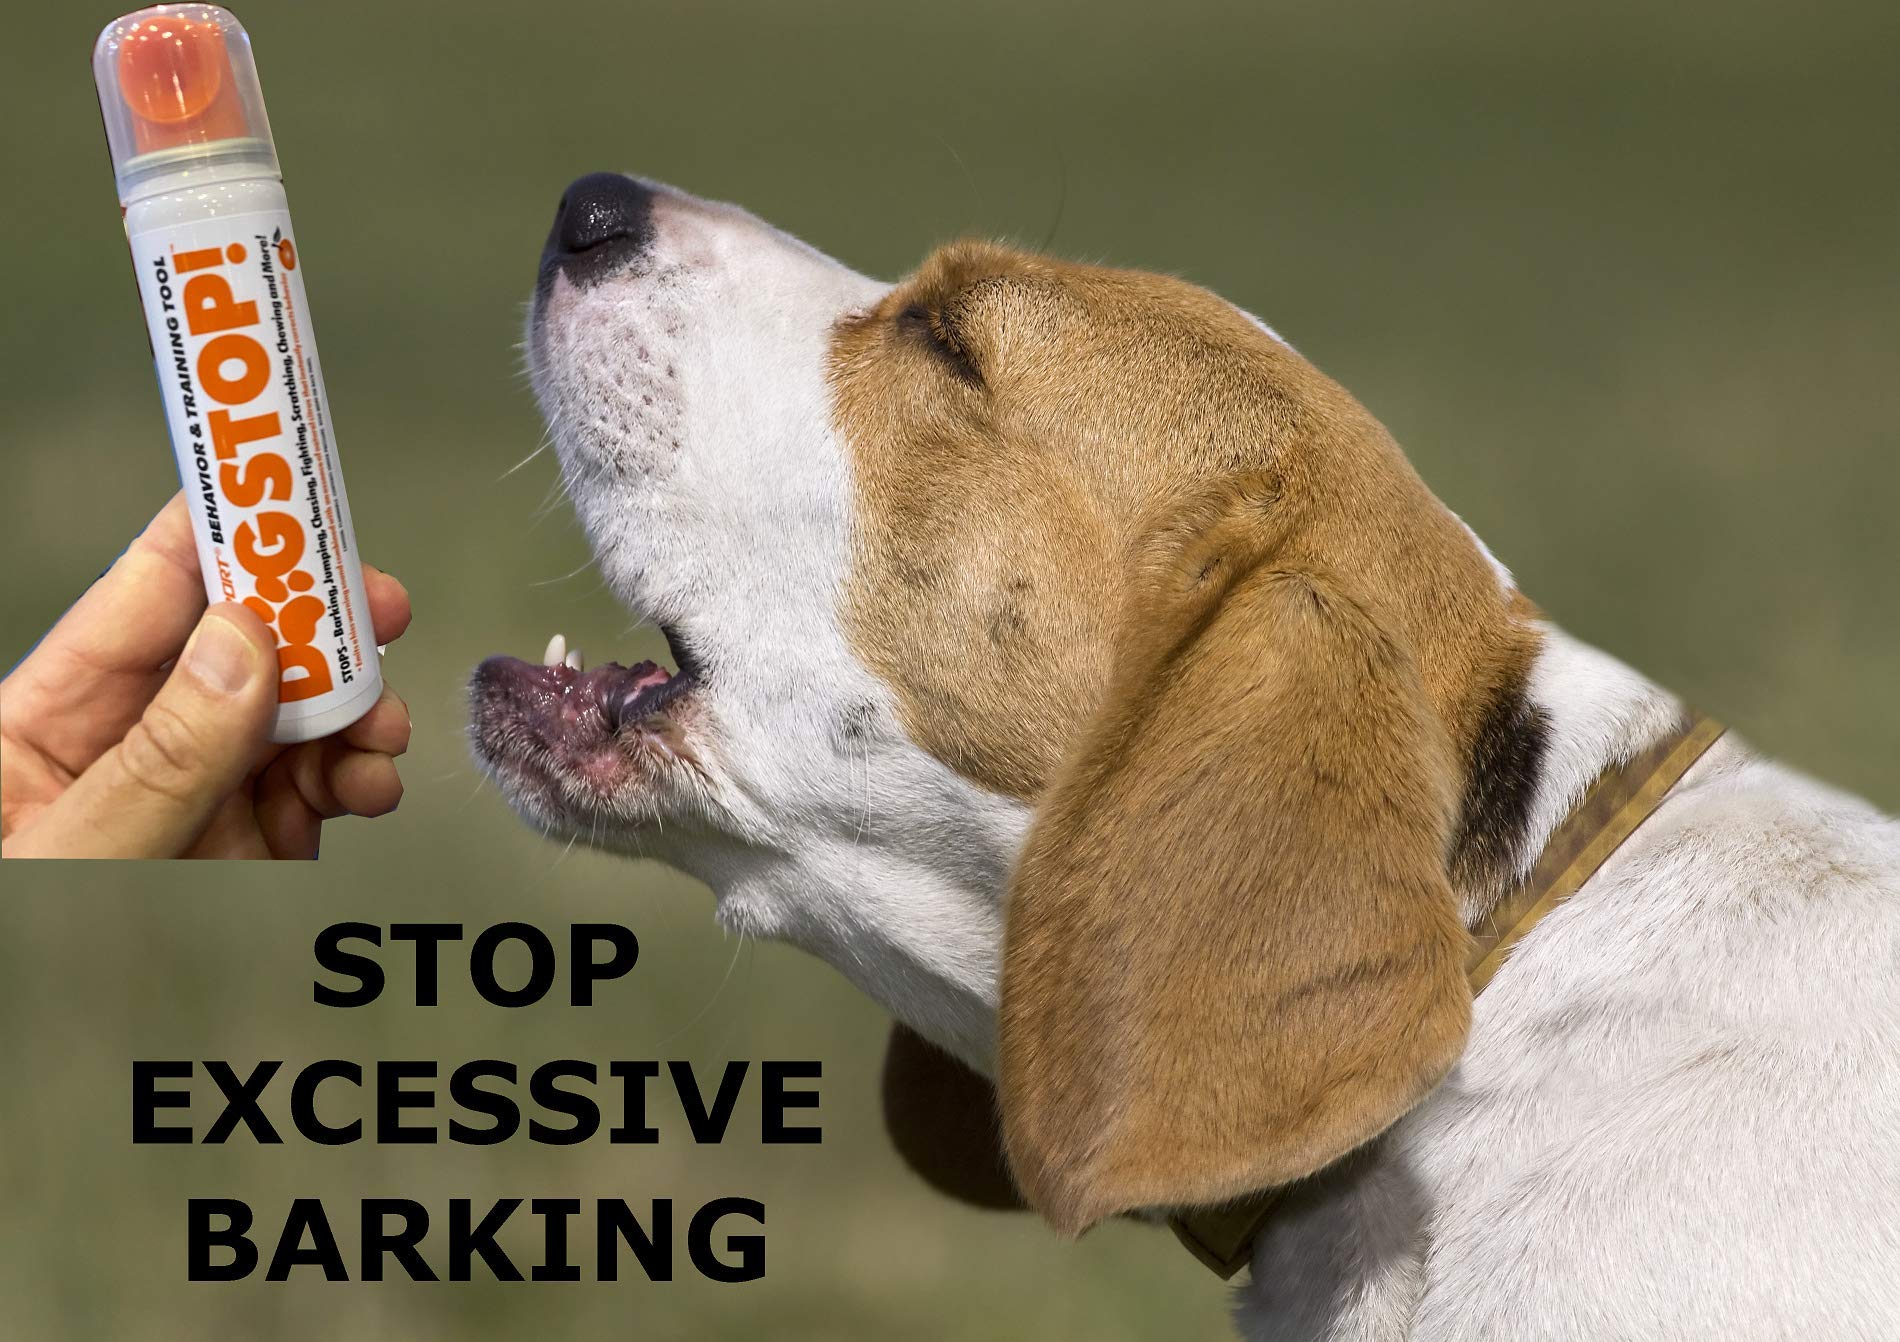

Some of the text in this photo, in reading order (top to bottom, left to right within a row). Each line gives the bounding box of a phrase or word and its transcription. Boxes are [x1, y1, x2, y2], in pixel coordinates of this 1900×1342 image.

[255, 235, 272, 272] More!
[153, 256, 174, 311] TOOL
[262, 274, 278, 298] and
[271, 300, 288, 353] Chewing
[166, 317, 197, 417] TRAINING
[282, 355, 302, 421] Scratching,
[189, 423, 201, 438] &
[295, 422, 312, 476] Fighting,
[193, 442, 223, 544] BEHAVIOR
[306, 477, 322, 528] Chasing,
[316, 529, 333, 583] Jumping,
